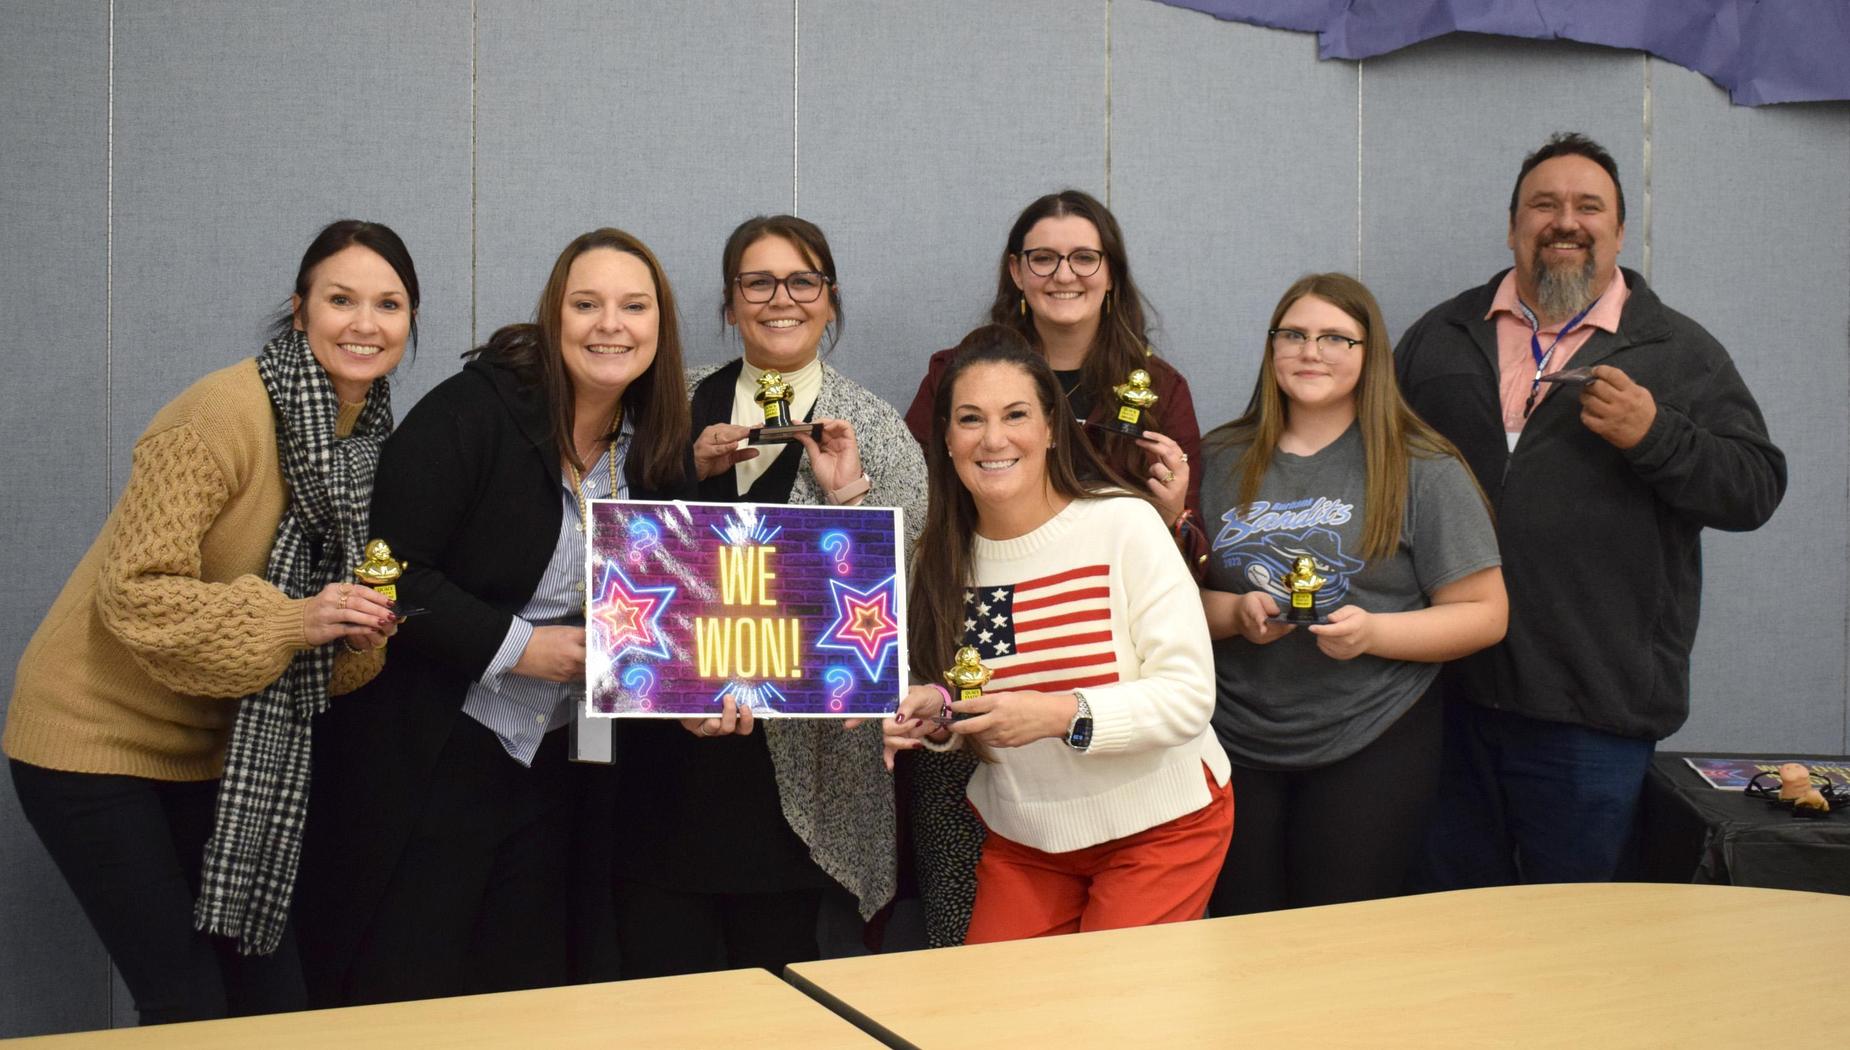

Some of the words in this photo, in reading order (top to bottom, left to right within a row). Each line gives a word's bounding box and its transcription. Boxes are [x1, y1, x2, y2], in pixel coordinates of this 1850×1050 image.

[1212, 496, 1354, 552] Bandits
[719, 545, 777, 606] WE
[696, 617, 801, 678] WON!
